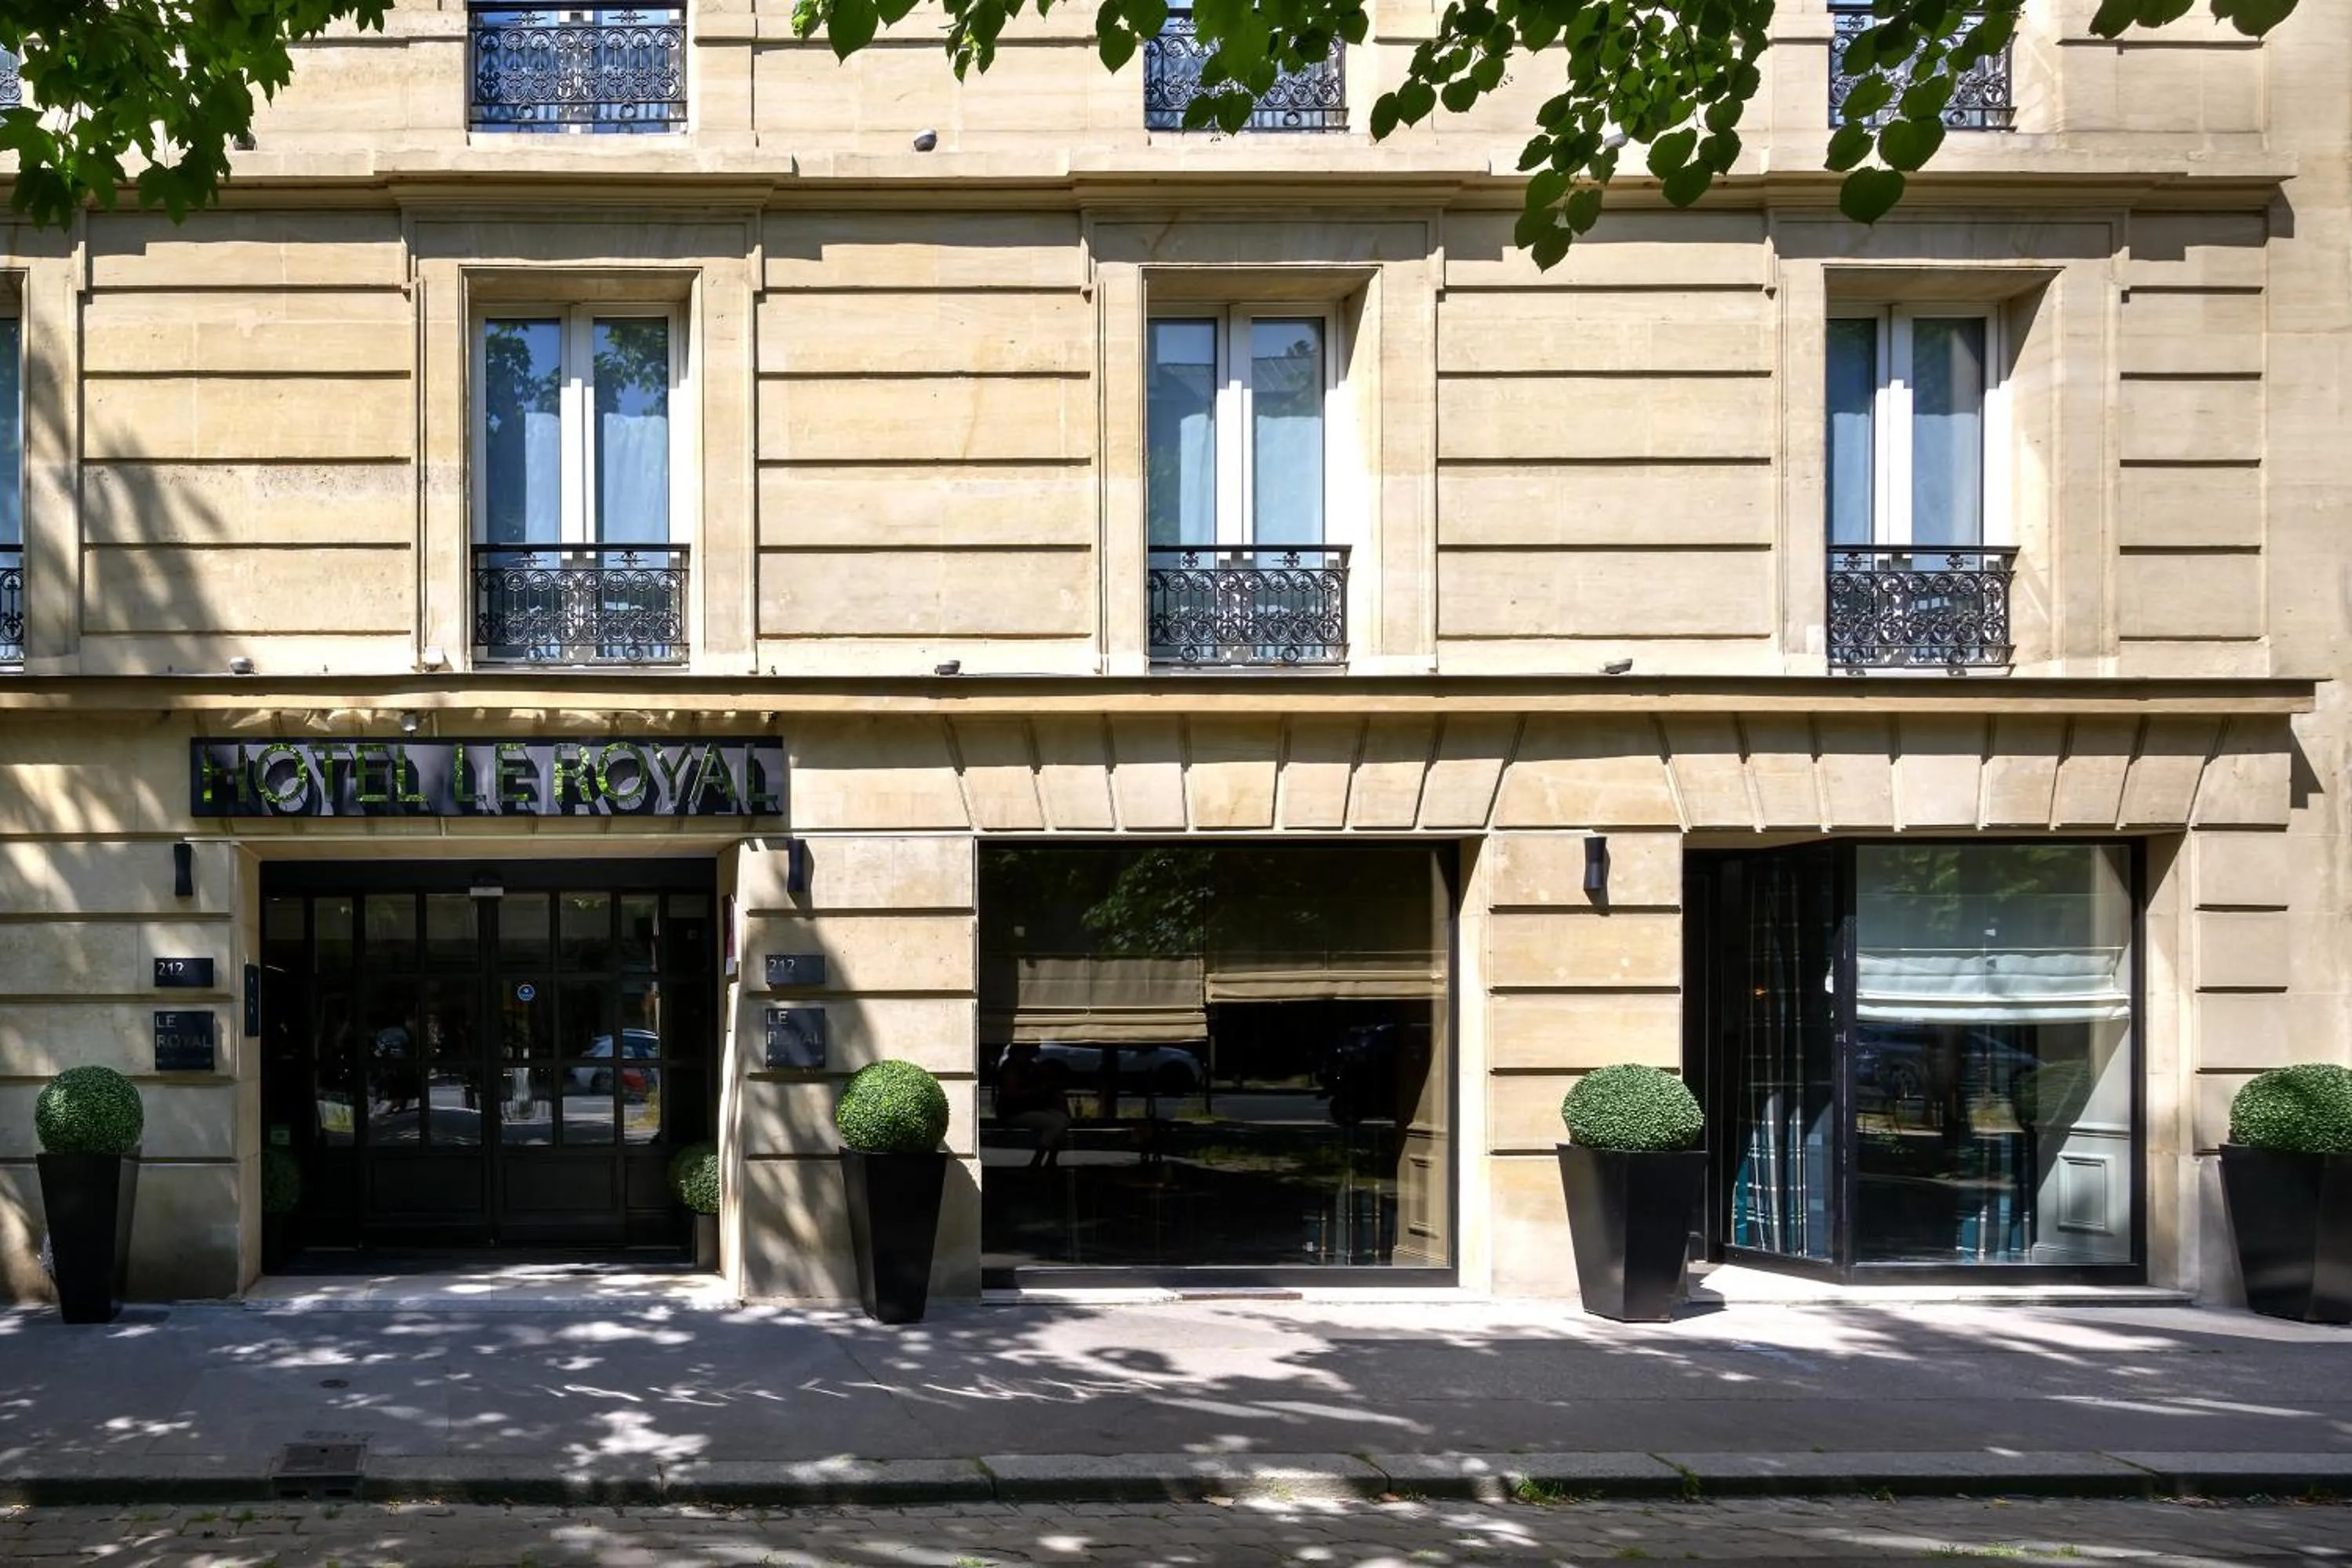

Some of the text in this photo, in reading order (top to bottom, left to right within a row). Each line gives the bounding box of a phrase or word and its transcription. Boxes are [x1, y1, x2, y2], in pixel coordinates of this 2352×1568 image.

[203, 742, 778, 803] HOTEL LE ROYAL
[158, 962, 185, 976] 212
[768, 959, 796, 973] 212
[156, 1014, 176, 1028] LE
[768, 1011, 788, 1025] LE
[156, 1034, 212, 1048] ROYAL
